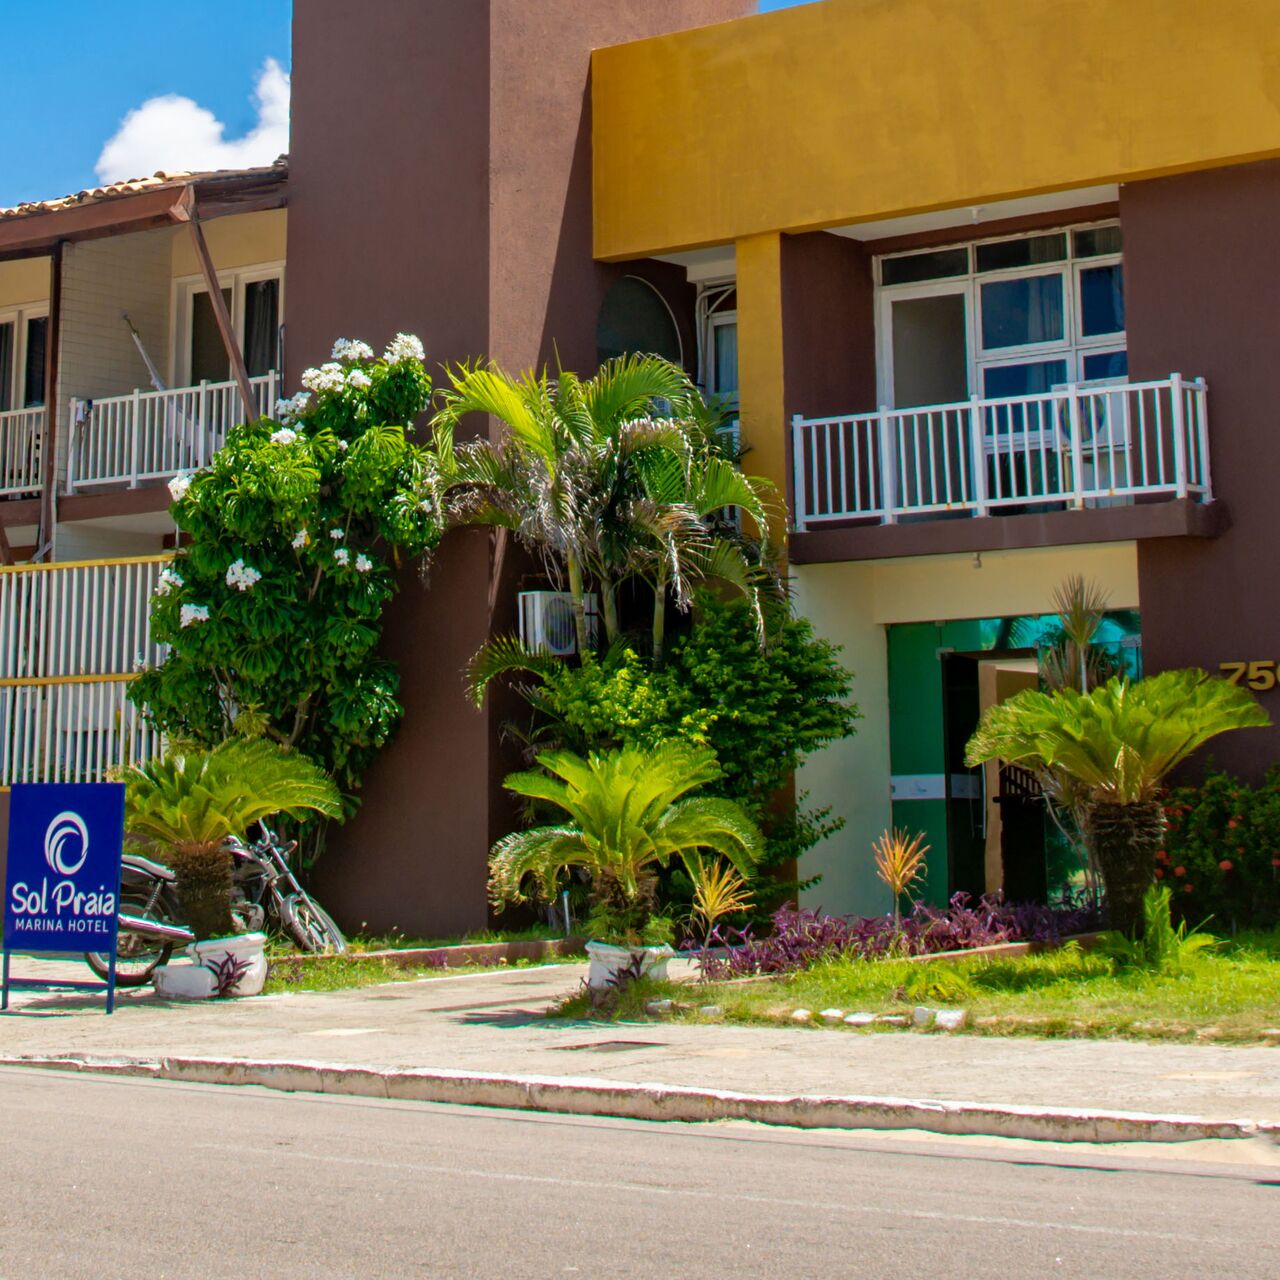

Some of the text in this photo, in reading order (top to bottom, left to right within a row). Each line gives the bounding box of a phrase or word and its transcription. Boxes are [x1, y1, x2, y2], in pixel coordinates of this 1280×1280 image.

[11, 877, 115, 915] Sol Praia
[16, 918, 109, 932] MARINA HOTEL
